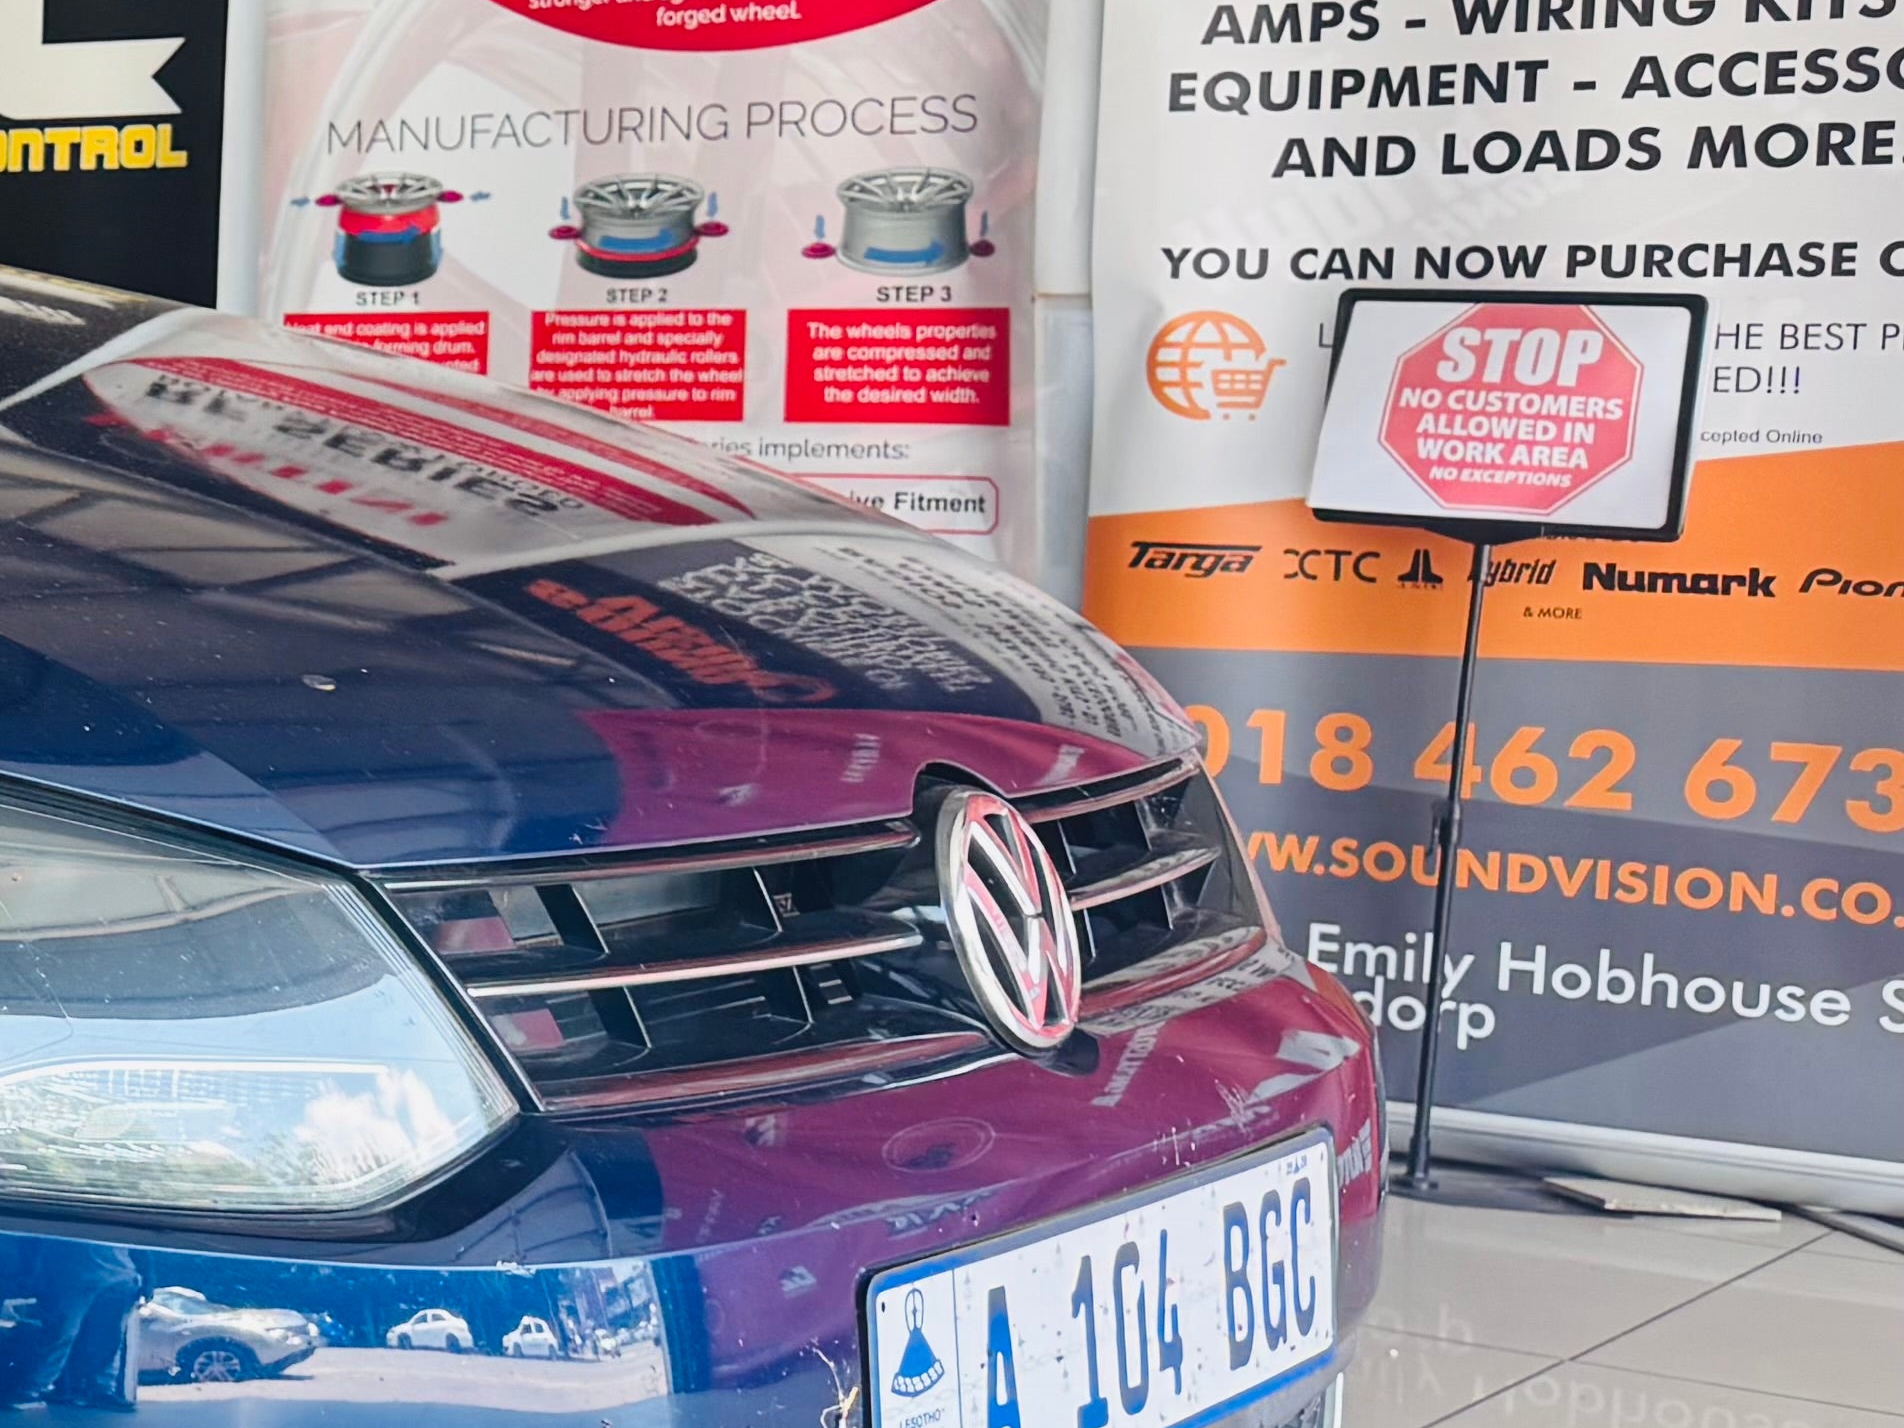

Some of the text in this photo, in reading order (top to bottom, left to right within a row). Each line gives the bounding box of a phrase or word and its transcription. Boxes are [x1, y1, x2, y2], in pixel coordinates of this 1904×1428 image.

[657, 2, 726, 29] forged
[1202, 0, 1379, 44] AMPS
[1169, 60, 1548, 115] EQUIPMENT
[325, 92, 980, 156] MANUFACTURING PROCESS
[1272, 136, 1415, 177] AND
[1442, 127, 1661, 174] LOADS
[1162, 248, 1268, 279] YOU
[1291, 247, 1394, 280] CAN
[1415, 245, 1547, 279] NOW
[1567, 242, 1857, 278] PURCHASE
[356, 291, 404, 306] STEP
[606, 288, 668, 304] STEP 2
[876, 286, 952, 303] STEP 3
[807, 322, 996, 346] The wheels properties
[1780, 323, 1866, 350] BEST
[813, 345, 991, 363] are compressed and
[1436, 326, 1604, 387] STOP
[814, 365, 989, 382] stretched to achieve
[824, 386, 978, 403] the desired width.
[1400, 388, 1623, 420] NO CUSTOMERS
[1417, 413, 1594, 444] ALLOWED IN
[1766, 429, 1823, 444] Online
[759, 438, 911, 461] implements:
[1418, 438, 1588, 469] WORK AREA
[1429, 466, 1571, 487] NO EXCEPTIONS
[894, 491, 986, 514] Fitment
[1128, 541, 1262, 578] Targa
[1582, 562, 1777, 598] Numark
[1538, 607, 1583, 620] MORE
[1414, 721, 1637, 811] 462
[1308, 922, 1476, 999] Emily
[1500, 941, 1851, 1027] Hobhouse
[1222, 1177, 1317, 1371] BGC
